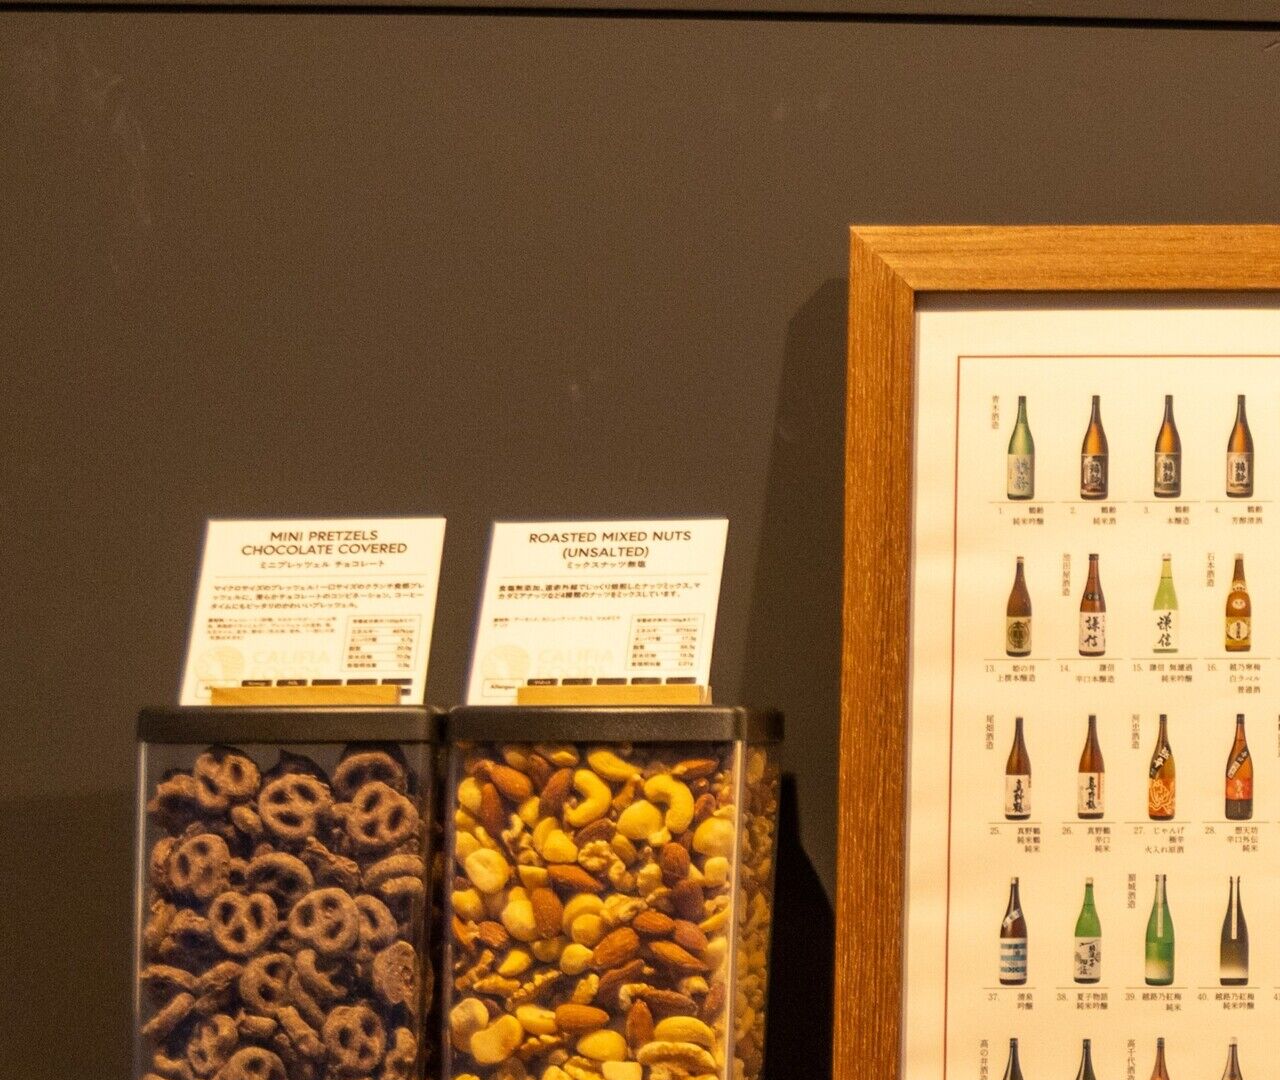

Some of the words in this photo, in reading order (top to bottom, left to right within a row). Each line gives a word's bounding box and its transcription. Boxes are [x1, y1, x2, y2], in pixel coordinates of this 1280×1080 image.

[270, 531, 303, 542] MINI
[309, 530, 378, 541] PRETZELS
[529, 532, 597, 543] ROASTED
[601, 531, 648, 542] MIXED
[652, 531, 692, 541] NUTS
[241, 545, 333, 556] CHOCOLATE
[338, 543, 408, 554] COVERED
[562, 547, 649, 559] (UNSALTED)
[1076, 1001, 1109, 1011] 純米吟醸
